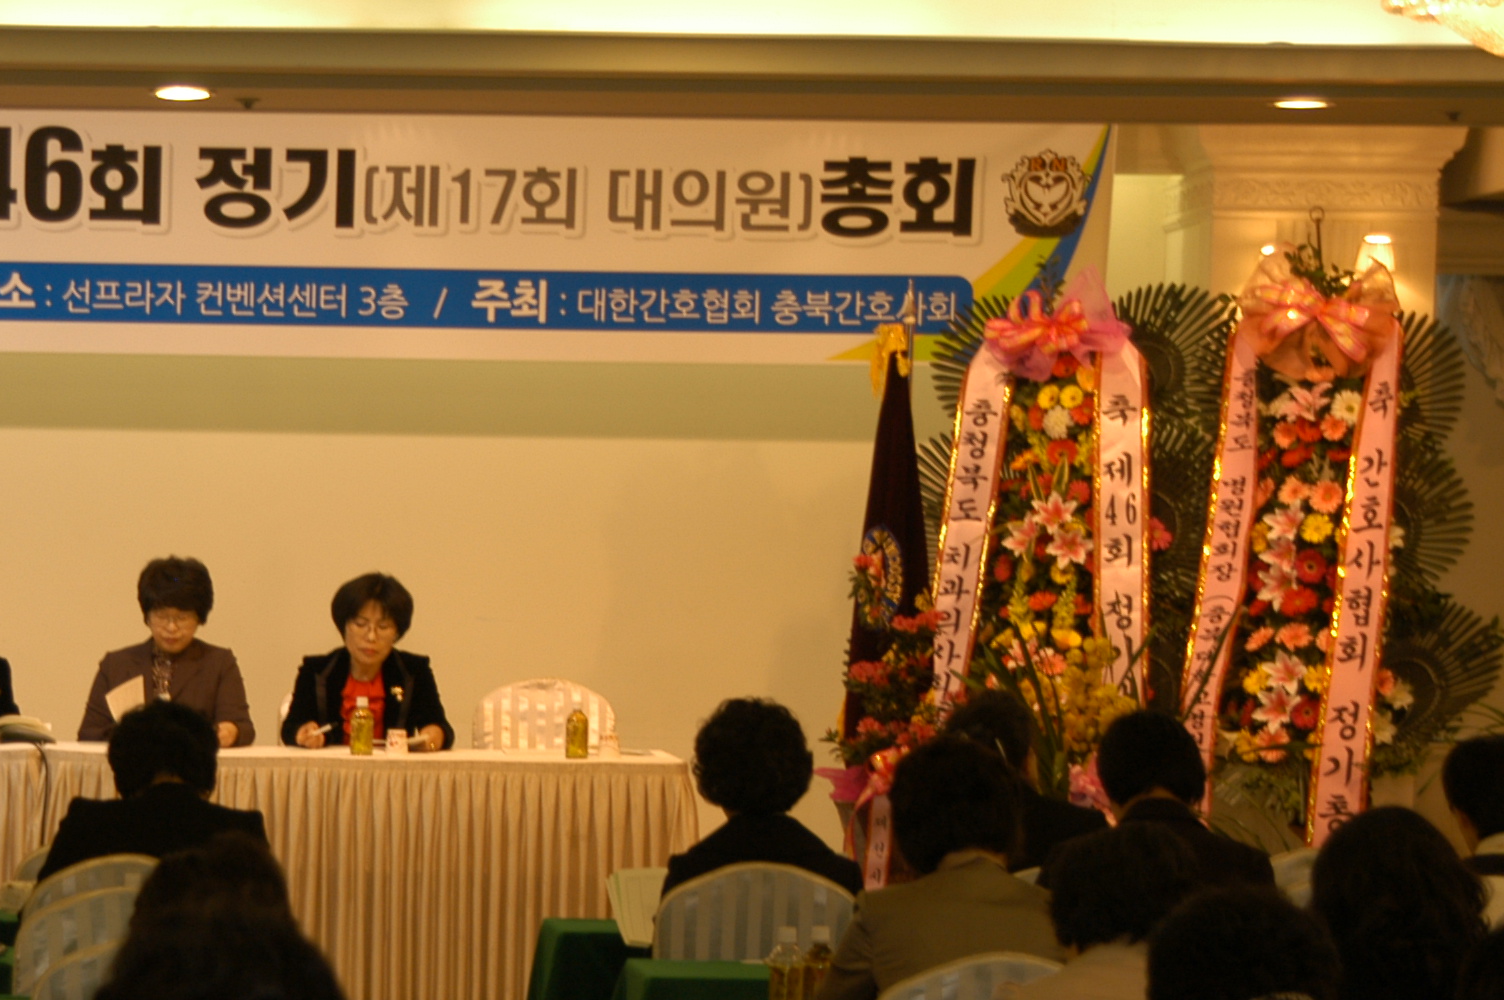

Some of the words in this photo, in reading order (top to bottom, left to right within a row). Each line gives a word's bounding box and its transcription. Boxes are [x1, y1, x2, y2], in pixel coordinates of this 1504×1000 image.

[62, 278, 186, 316] 선프라자
[195, 279, 347, 318] 컨벤션센터
[359, 283, 408, 320] 3층
[577, 287, 760, 325] 대한간호협회
[771, 289, 956, 325] 충북간호사회
[949, 397, 999, 524] 충청북도
[1102, 450, 1139, 568] 제46회
[1336, 447, 1389, 674] 간호사협회
